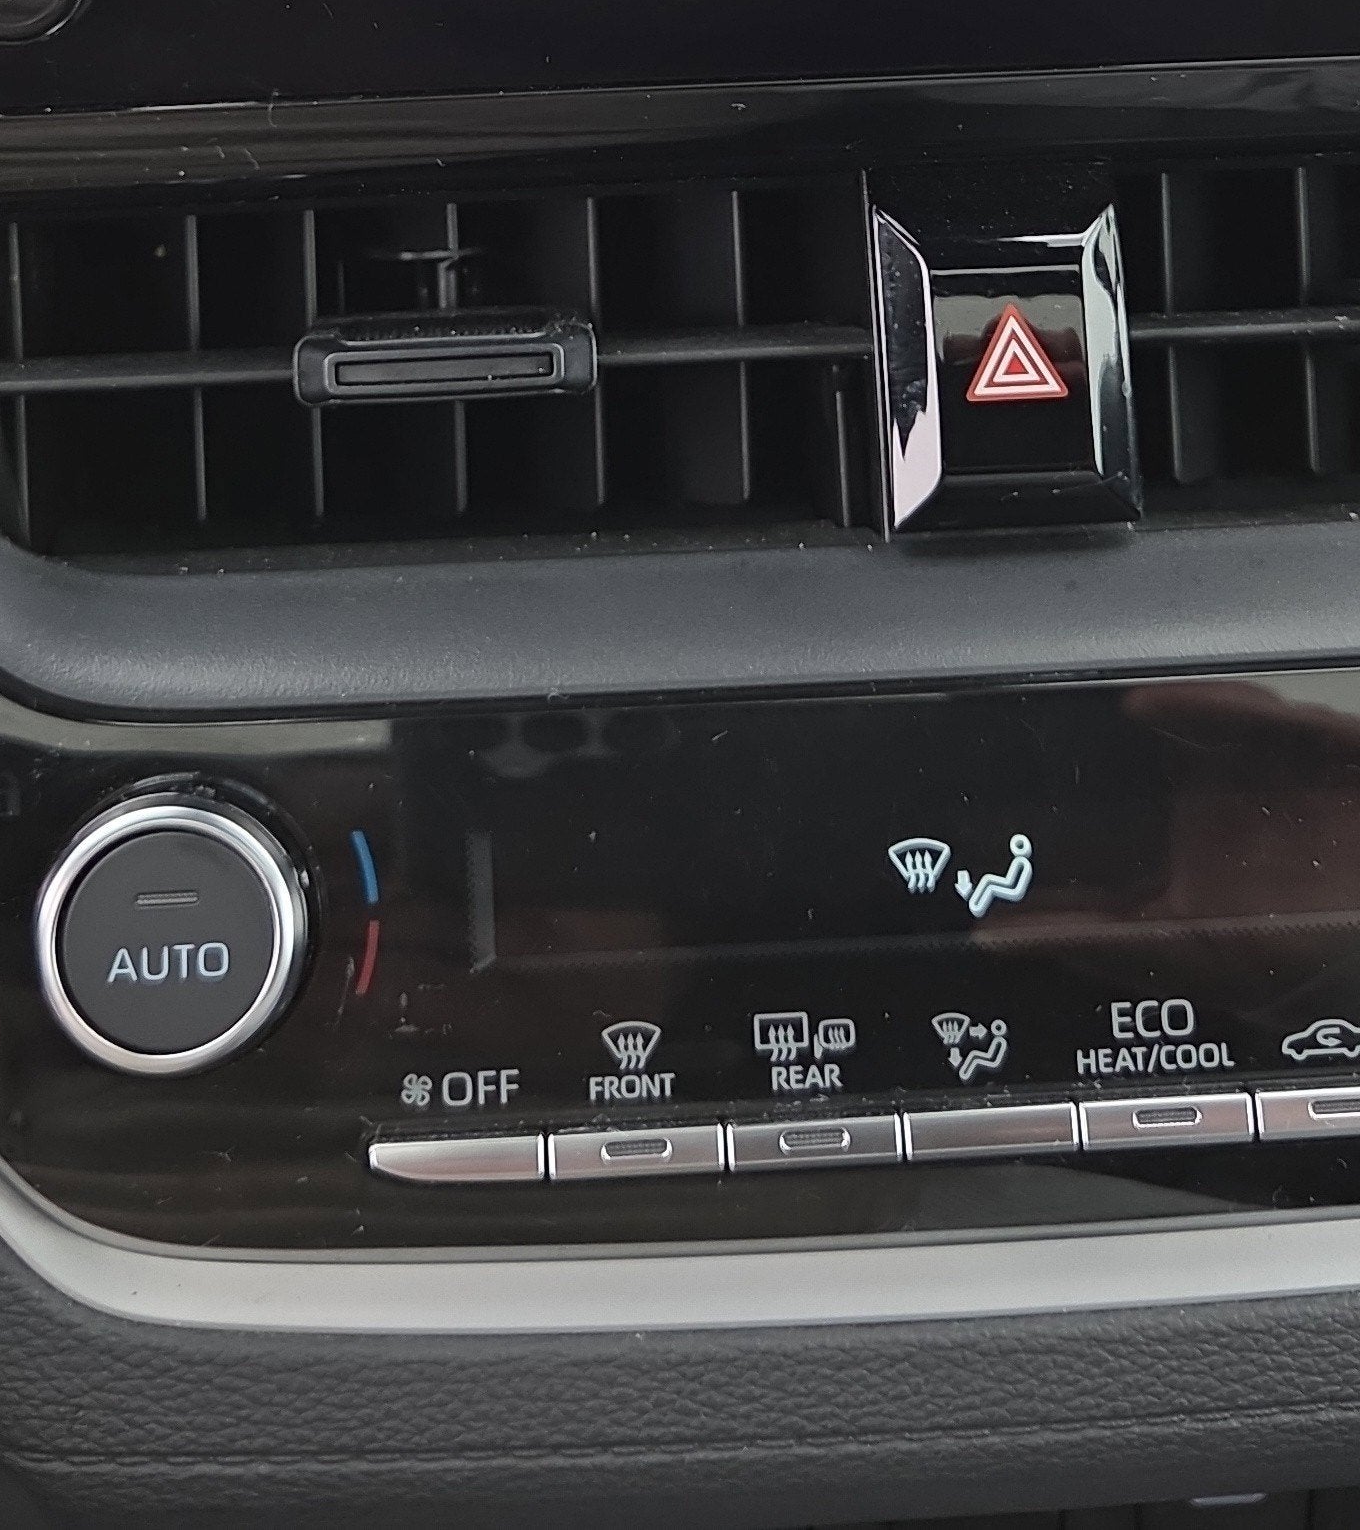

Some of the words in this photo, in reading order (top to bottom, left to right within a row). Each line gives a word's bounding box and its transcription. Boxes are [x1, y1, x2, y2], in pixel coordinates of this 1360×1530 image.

[106, 940, 230, 983] AUTO
[1110, 997, 1196, 1040] ECO
[1076, 1041, 1236, 1076] HEAT/COOL
[441, 1069, 520, 1108] OFF
[588, 1072, 676, 1102] FRONT
[770, 1063, 843, 1092] REAR
